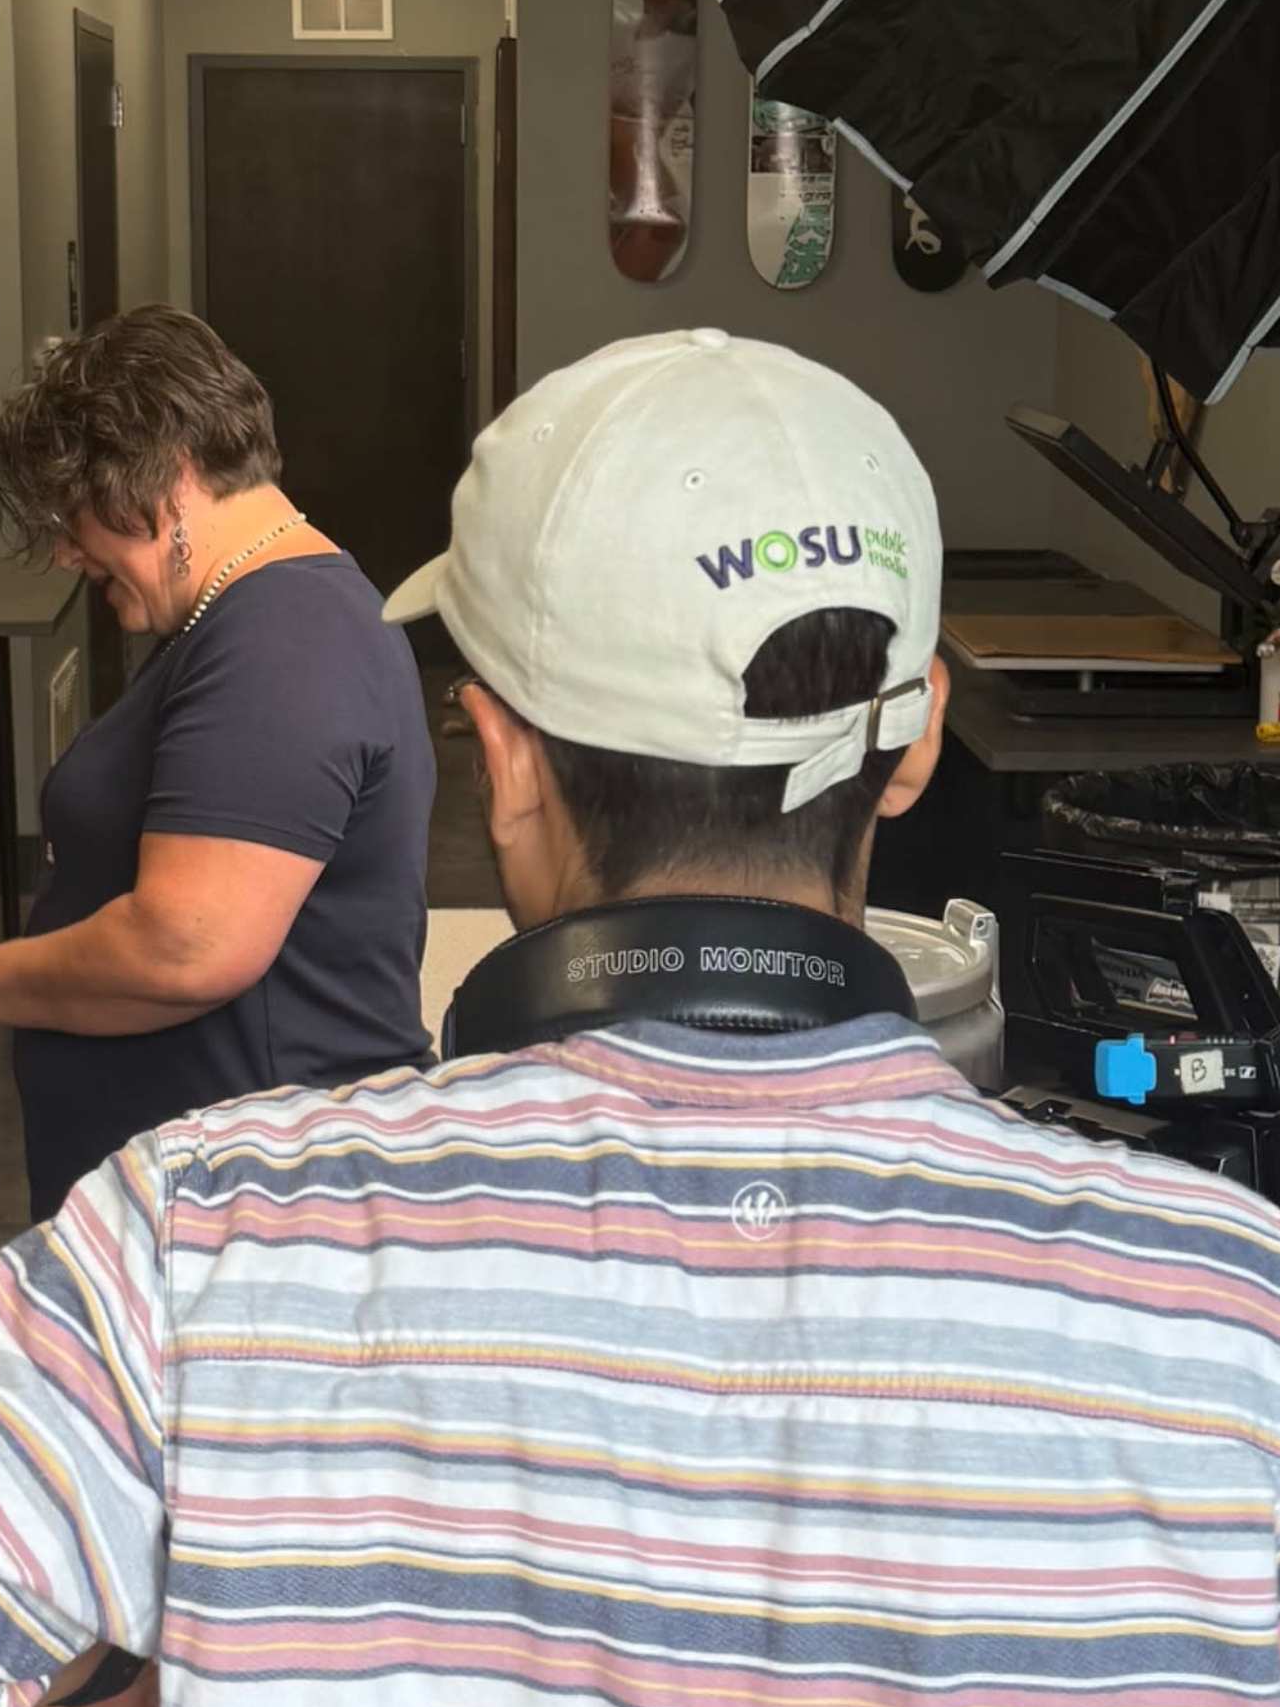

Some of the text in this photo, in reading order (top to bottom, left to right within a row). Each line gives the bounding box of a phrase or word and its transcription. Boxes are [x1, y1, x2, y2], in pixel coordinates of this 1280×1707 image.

[695, 524, 863, 591] WOSU
[864, 524, 907, 556] public
[567, 945, 847, 987] STUDIO MONITOR
[1190, 1057, 1208, 1083] B
